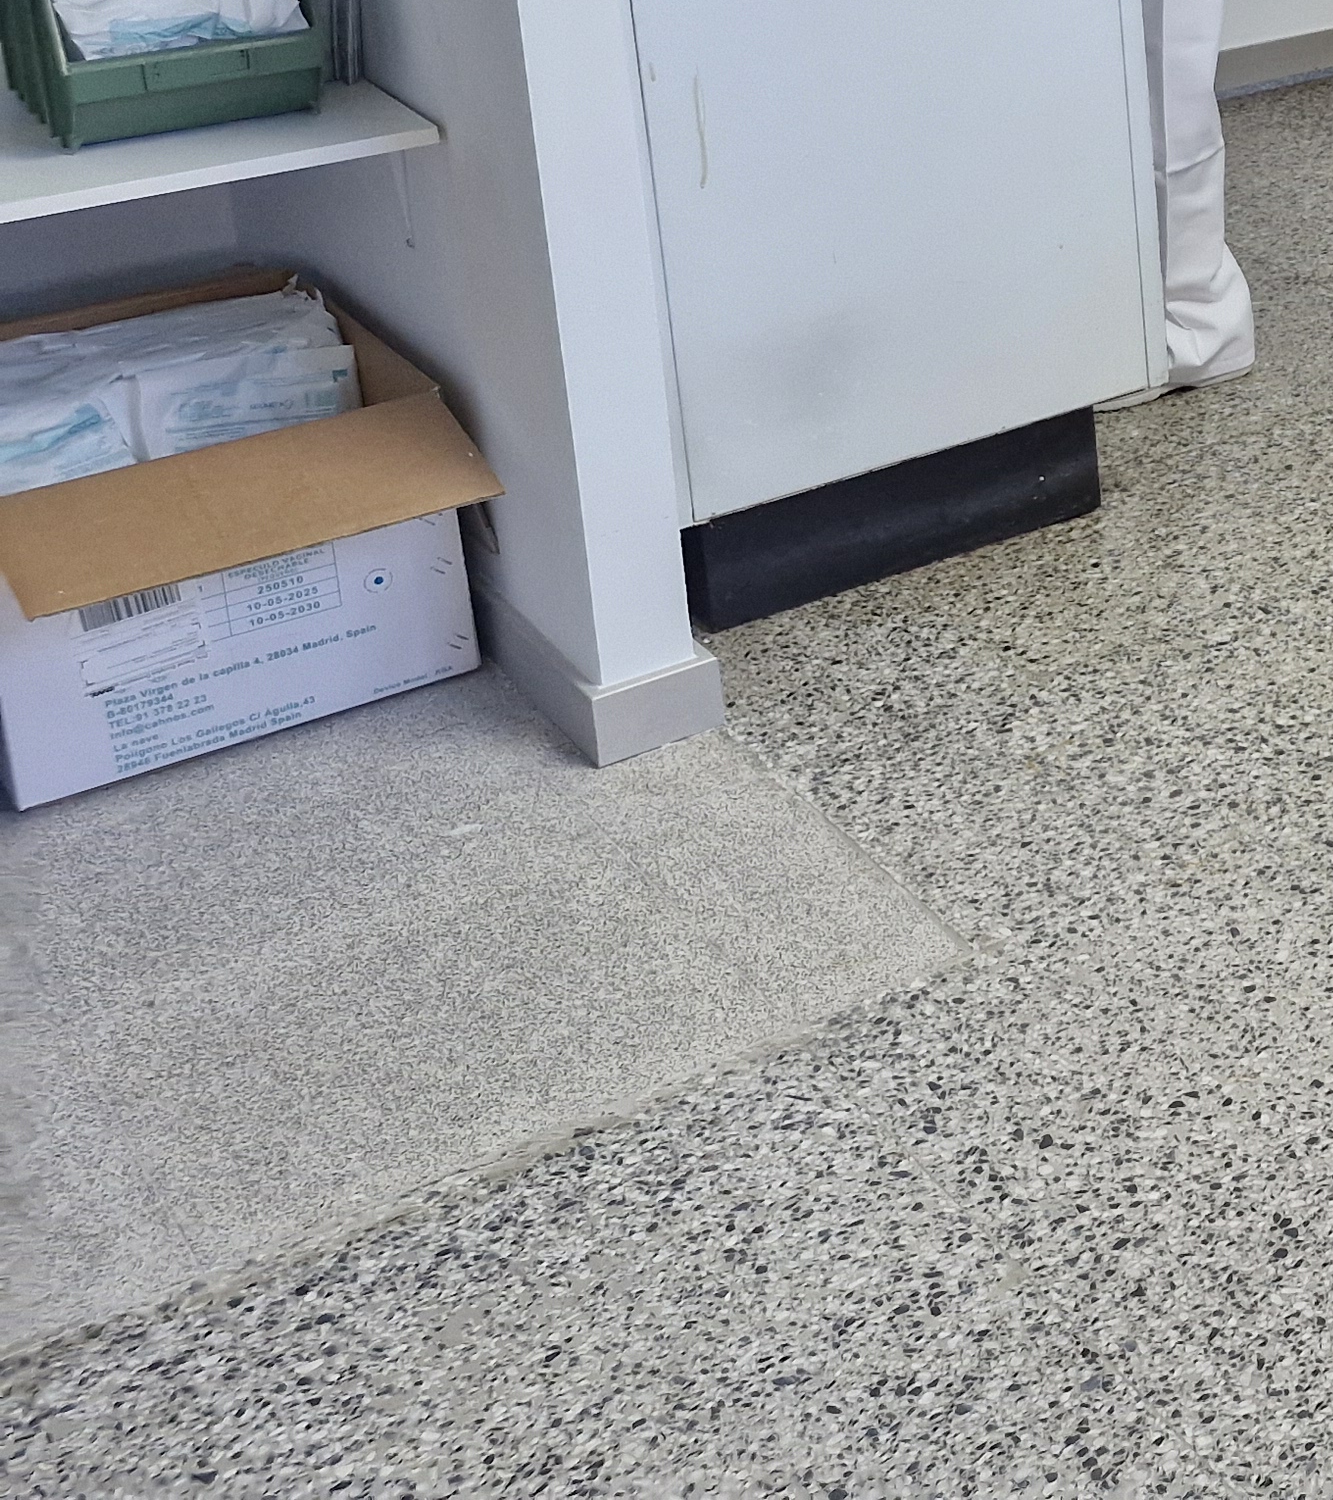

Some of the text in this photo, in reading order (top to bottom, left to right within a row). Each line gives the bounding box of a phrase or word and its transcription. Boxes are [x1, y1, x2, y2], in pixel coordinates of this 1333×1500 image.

[257, 576, 304, 595] 250510
[247, 586, 319, 611] 10-05-2025
[250, 601, 321, 627] 10-05-2030
[105, 694, 137, 708] Plaza
[139, 682, 178, 698] Virgen
[181, 677, 196, 686] de
[199, 673, 209, 681] la
[267, 646, 299, 661] 28034
[346, 624, 377, 638] Spain
[177, 699, 190, 709] 22
[155, 735, 225, 761] Fuenlabrada
[229, 721, 267, 738] Madrid
[271, 712, 302, 726] Spain
